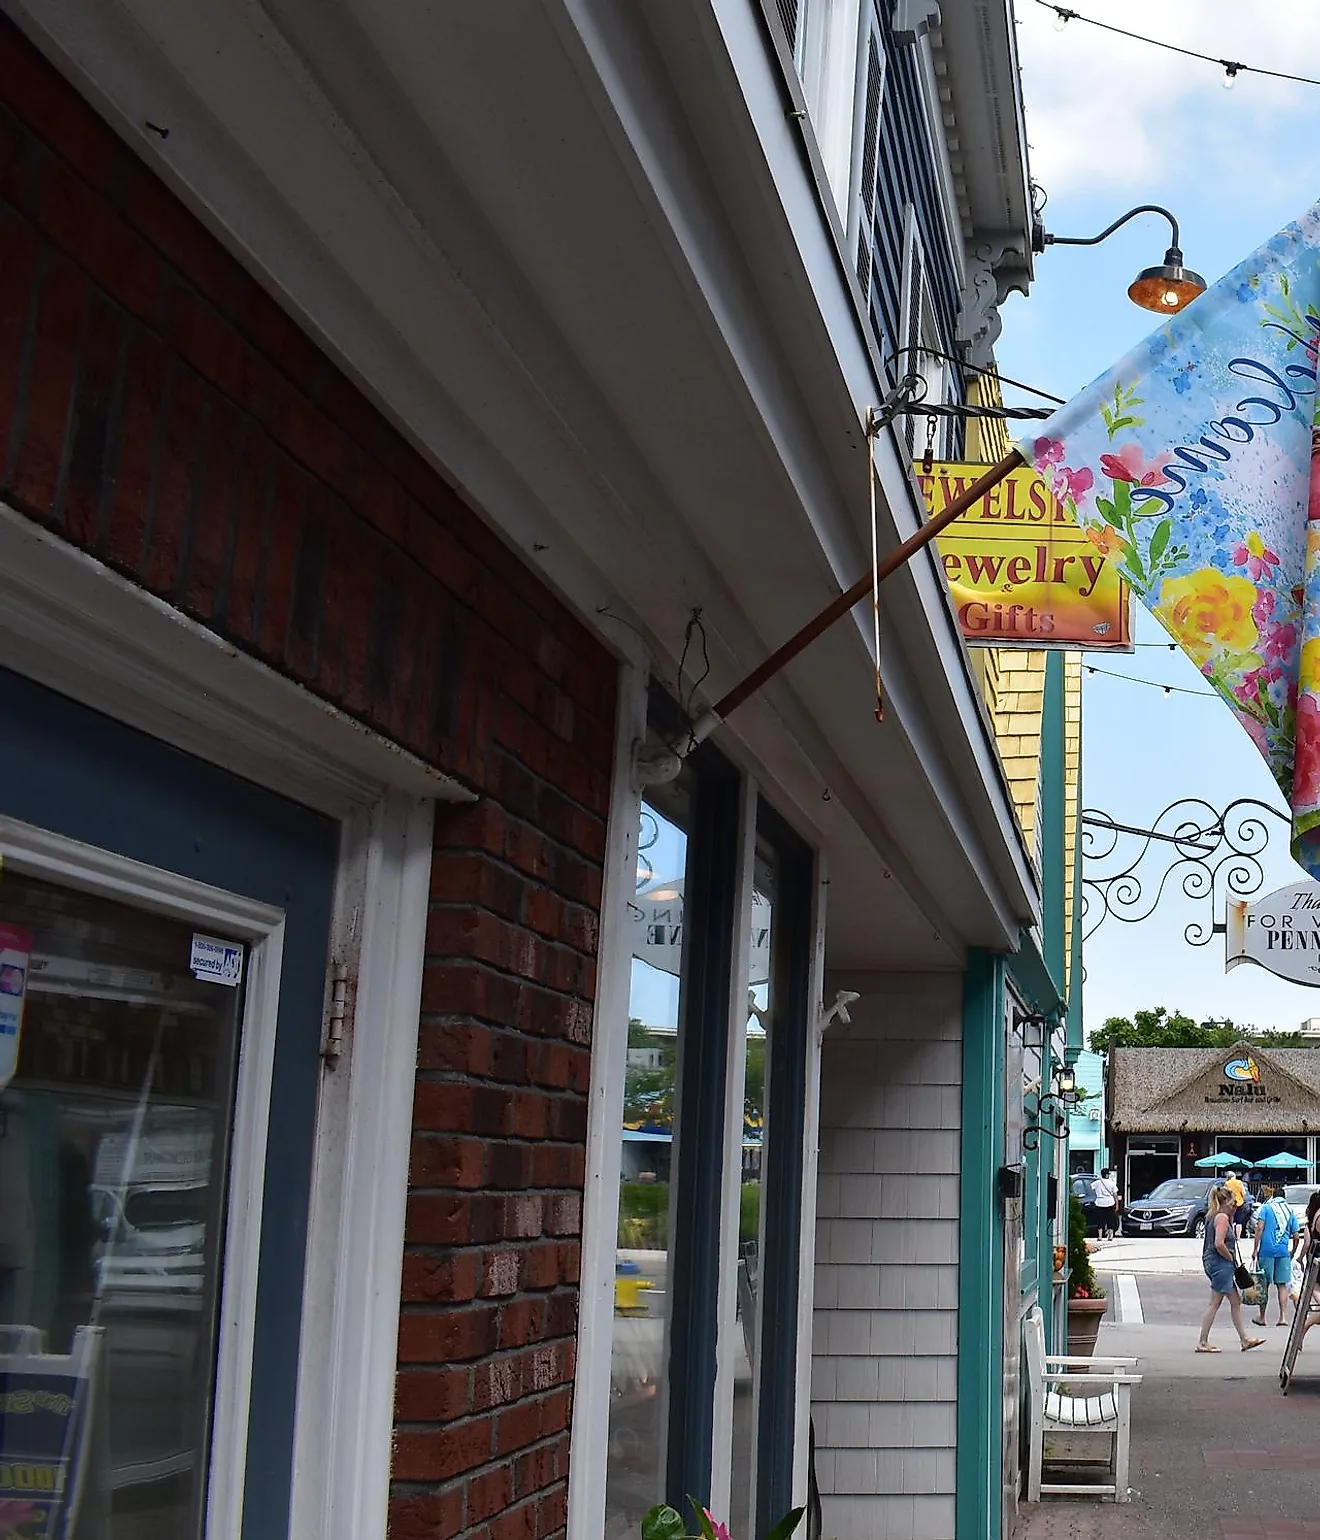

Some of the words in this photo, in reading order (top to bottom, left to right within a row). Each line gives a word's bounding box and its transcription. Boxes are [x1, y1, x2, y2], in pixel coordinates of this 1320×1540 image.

[941, 546, 1106, 597] ewelry
[1001, 583, 1014, 593] &
[958, 602, 1055, 633] Gifts
[1247, 915, 1293, 929] FOR
[1218, 1083, 1267, 1096] Nalu
